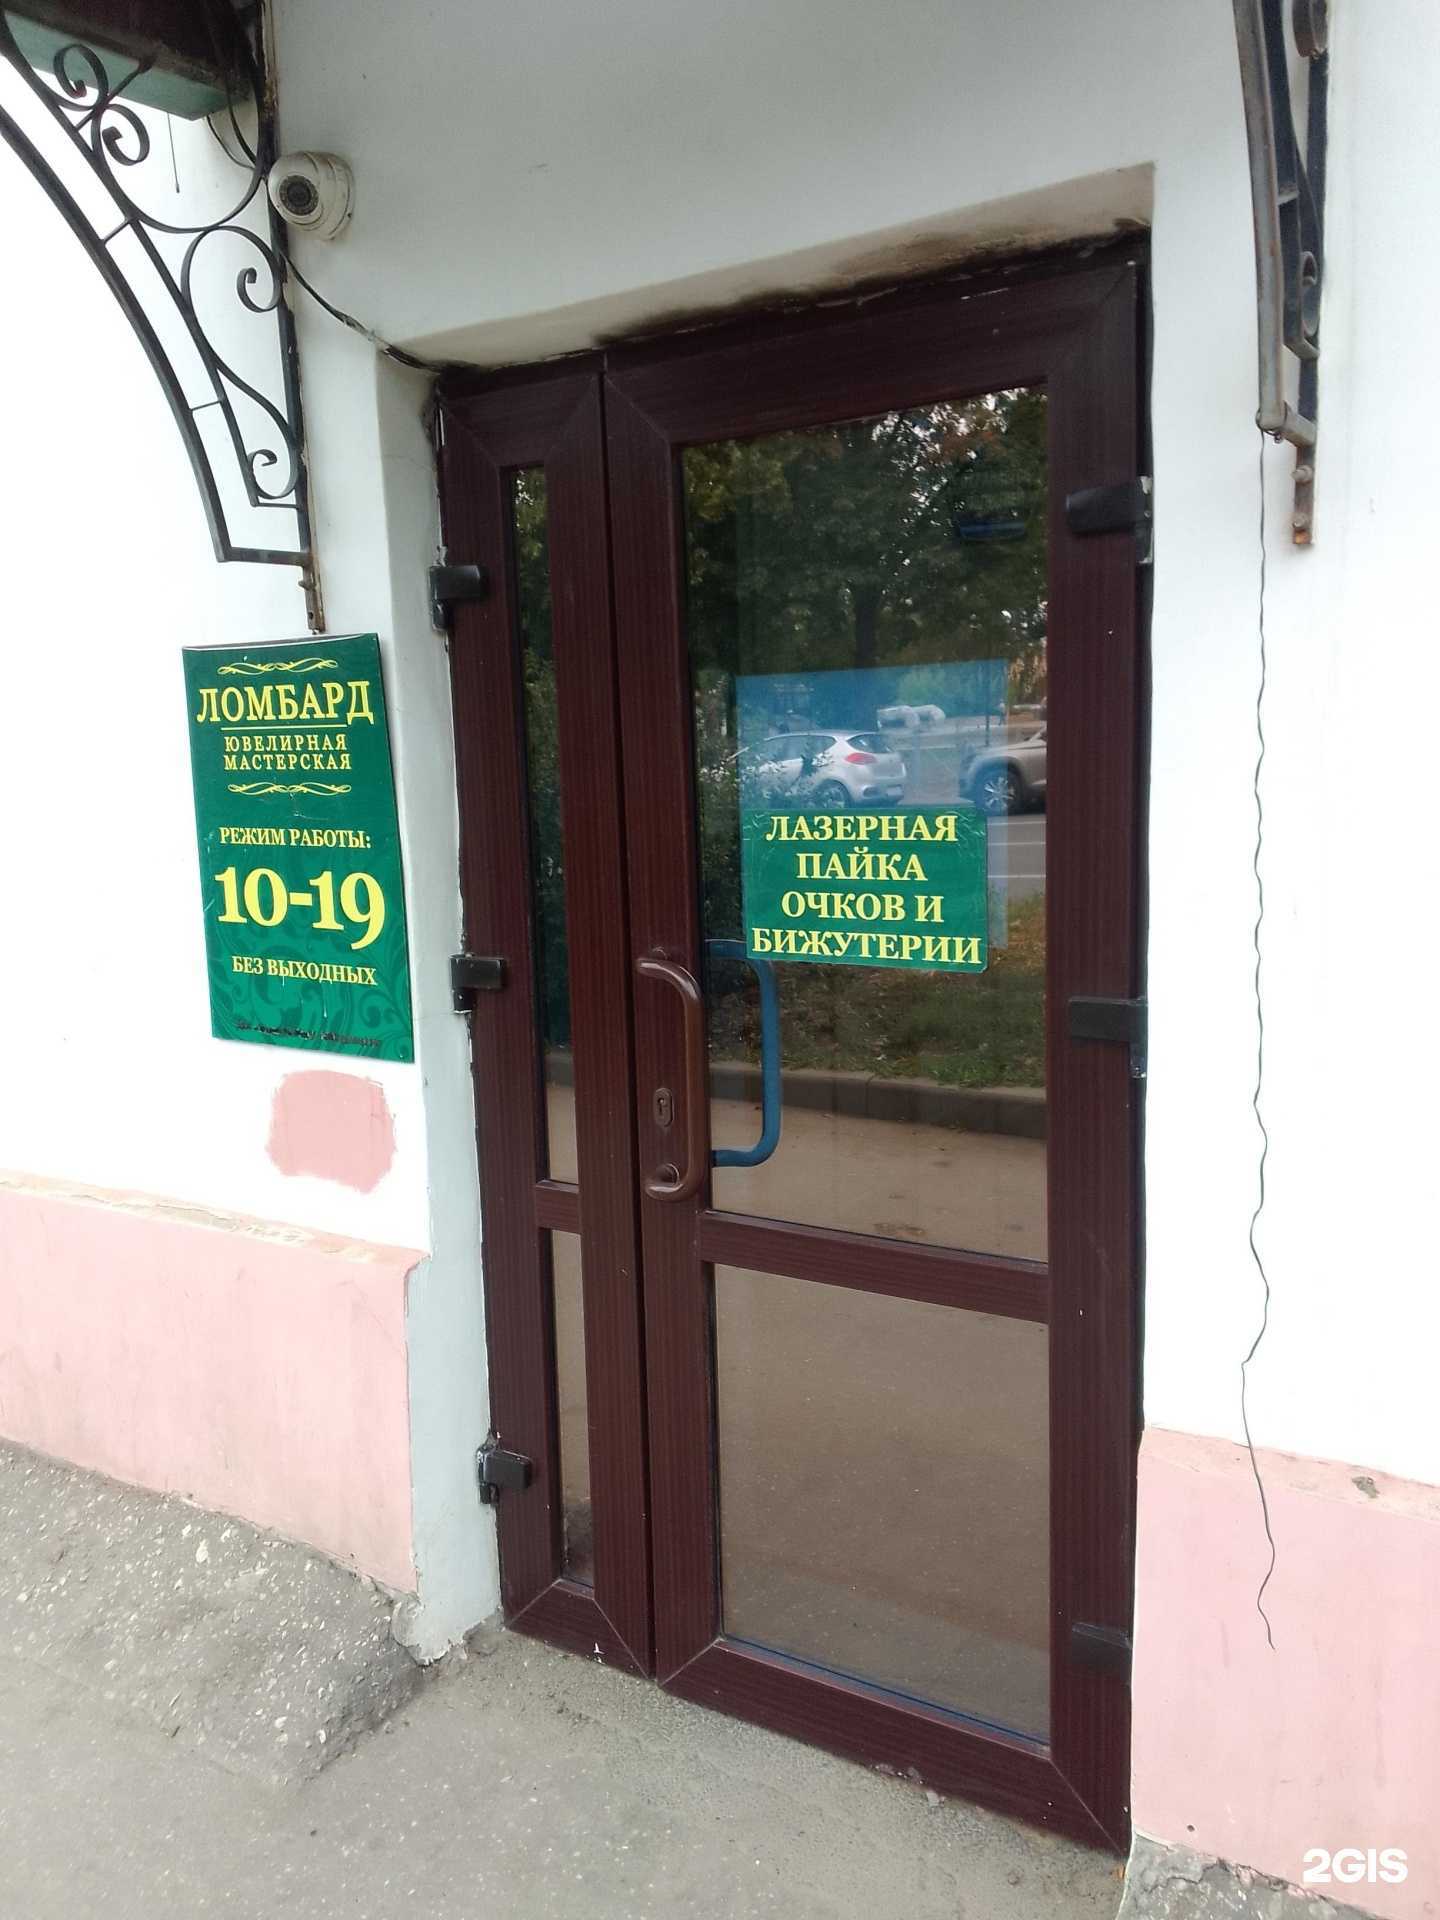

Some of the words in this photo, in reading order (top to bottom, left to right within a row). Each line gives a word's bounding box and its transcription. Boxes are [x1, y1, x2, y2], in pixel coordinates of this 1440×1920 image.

[196, 680, 375, 725] ЛОМБАРД
[224, 733, 348, 754] ЮВЕЛИРНАЯ
[223, 753, 352, 771] МАСТЕРСКАЯ
[219, 826, 286, 846] РЕЖИМ
[289, 828, 372, 849] РАБОТЫ:
[765, 814, 958, 842] ЛАЗЕРНАЯ
[796, 846, 928, 882] ПАЙКА
[214, 866, 386, 950] 10-19
[781, 891, 906, 921] ОЧКОВ
[915, 895, 944, 923] И
[751, 927, 982, 964] БИЖУТЕРИИ
[231, 955, 264, 975] БЕЗ
[267, 958, 378, 986] ВЫХОДНЫХ
